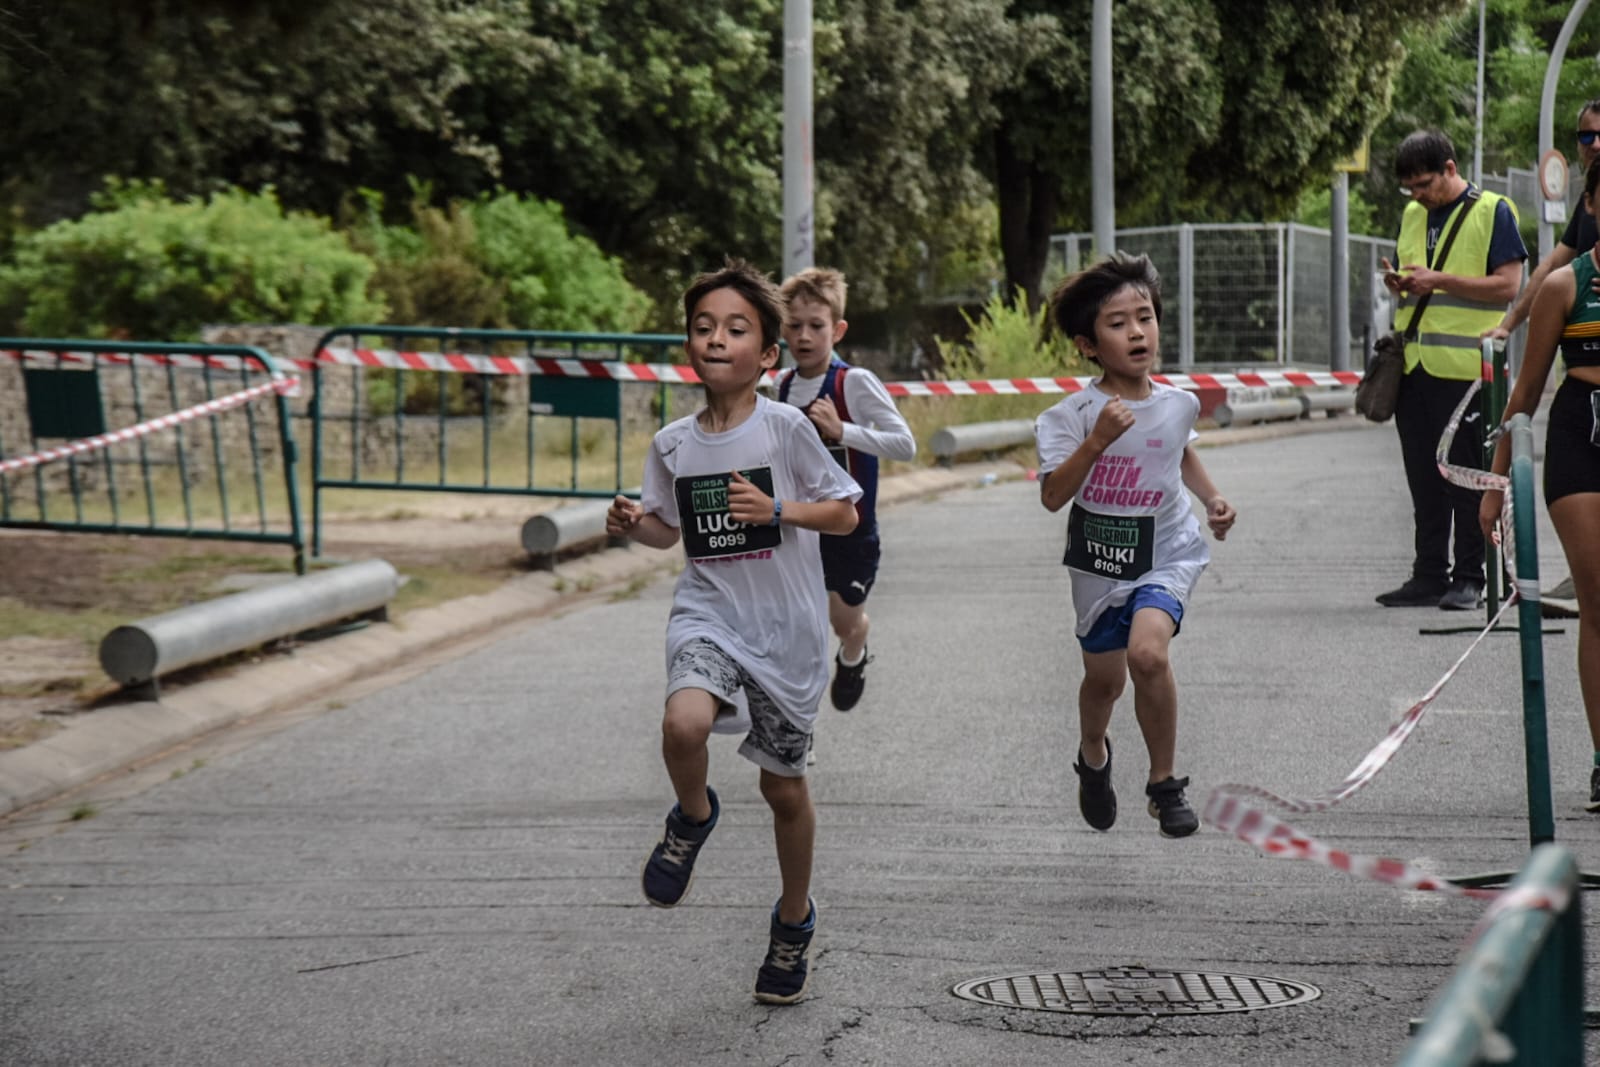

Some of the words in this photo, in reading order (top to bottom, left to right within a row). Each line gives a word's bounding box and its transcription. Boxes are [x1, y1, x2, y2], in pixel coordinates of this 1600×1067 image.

[692, 479, 725, 489] CURSA
[1090, 464, 1142, 489] RUN
[1082, 485, 1164, 508] CONQUER
[708, 533, 747, 548] 6099
[1085, 524, 1137, 545] COLLSEROLA
[1087, 540, 1135, 564] ITUKI
[1094, 558, 1122, 574] 6105
